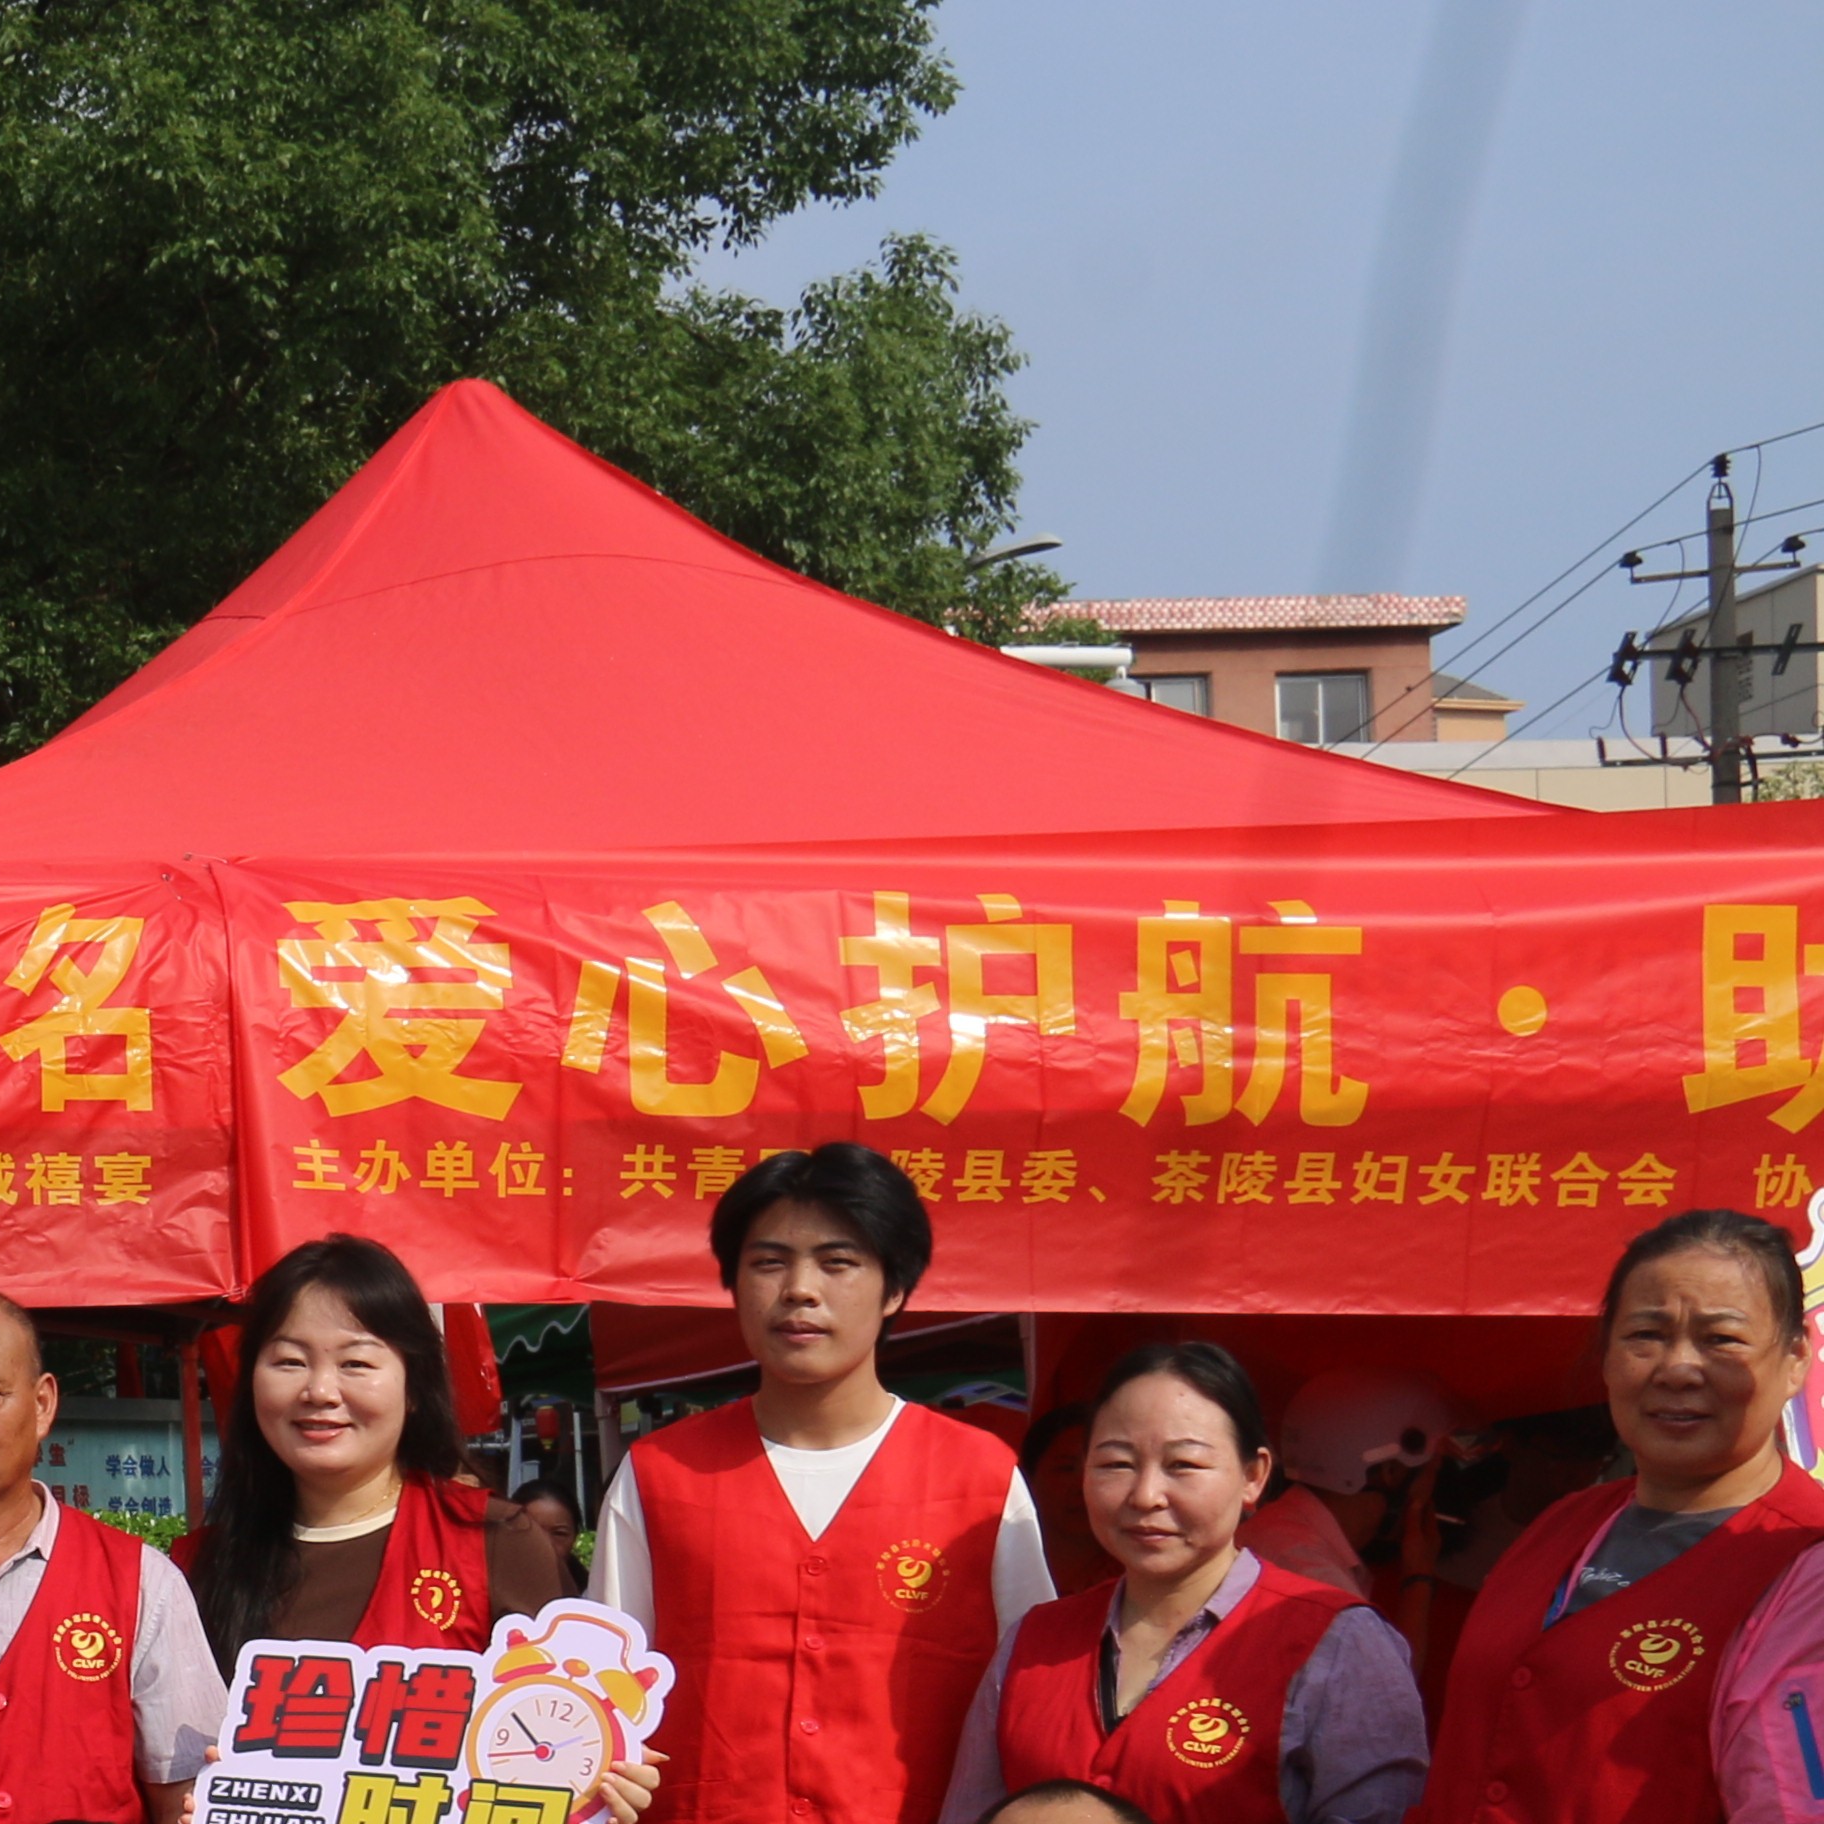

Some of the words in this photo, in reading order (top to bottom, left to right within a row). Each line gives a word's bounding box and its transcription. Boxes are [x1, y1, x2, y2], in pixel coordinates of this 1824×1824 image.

[293, 1140, 1678, 1208] 主办单位：共青陵县委、茶陵县妇女联合会
[105, 1455, 171, 1478] 学会做人
[895, 1589, 929, 1600] CLVF
[72, 1659, 106, 1669] CLVF
[1624, 1660, 1666, 1679] CLVF
[233, 1654, 477, 1770] 珍惜
[548, 1700, 574, 1723] 12
[495, 1727, 510, 1747] 9
[1182, 1741, 1222, 1755] CLVF
[579, 1757, 593, 1777] 3
[209, 1779, 321, 1805] ZHENXI
